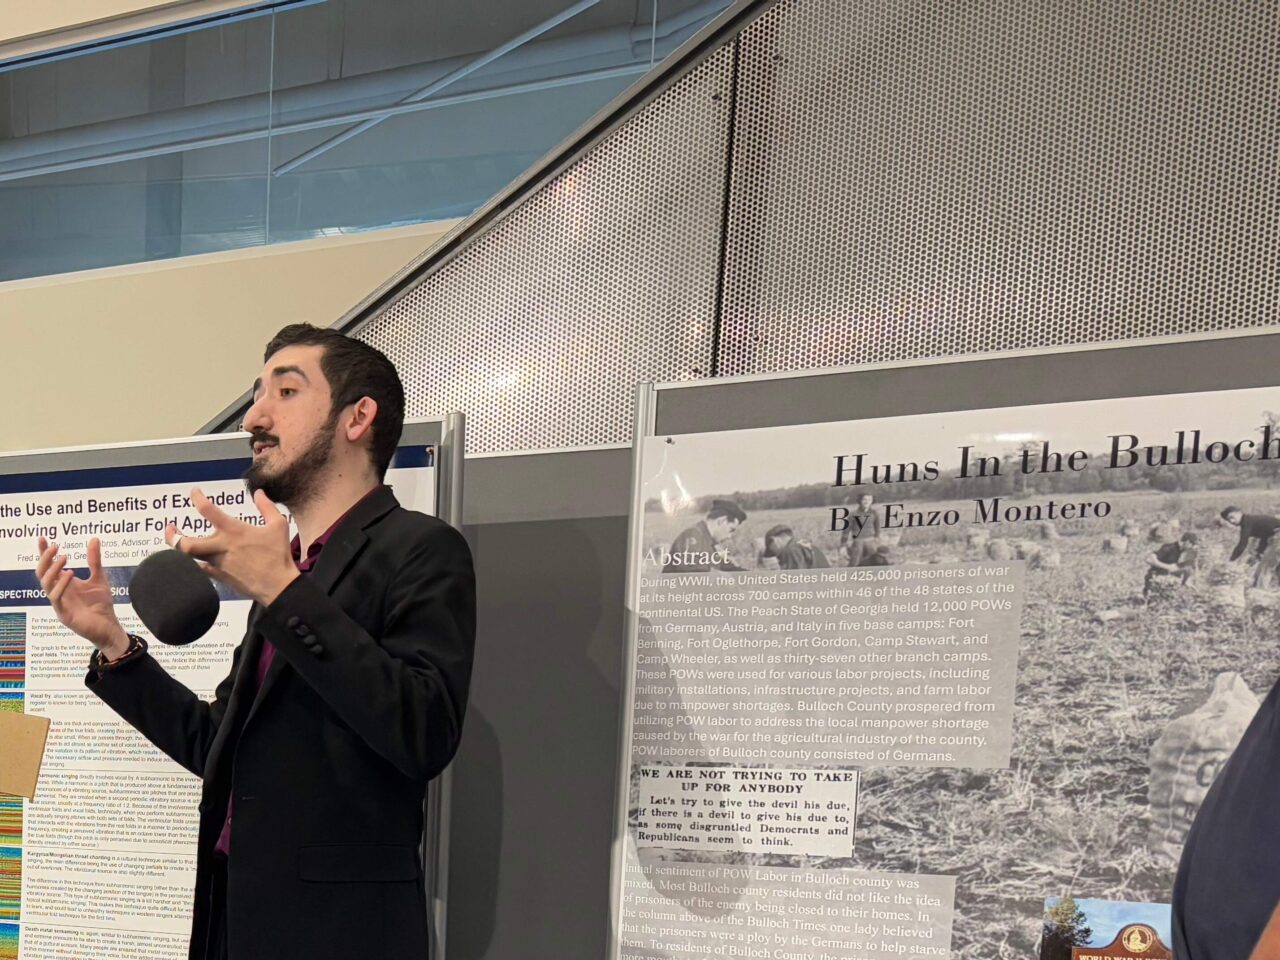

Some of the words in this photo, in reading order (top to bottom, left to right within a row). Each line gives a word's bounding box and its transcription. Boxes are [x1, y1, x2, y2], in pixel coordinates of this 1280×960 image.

[831, 453, 940, 488] Huns
[954, 445, 1002, 479] In
[1018, 441, 1089, 475] the
[1105, 425, 1280, 469] Bulloch
[0, 504, 21, 518] the
[26, 502, 53, 516] Use
[57, 501, 84, 515] and
[89, 496, 150, 513] Benefits
[152, 494, 168, 510] of
[172, 490, 245, 508] Exnded
[828, 506, 870, 538] By
[881, 503, 961, 529] Enzo
[972, 498, 1113, 525] Montero
[62, 519, 139, 537] Ventricular
[62, 541, 84, 549] Jason
[17, 554, 34, 562] Fred
[104, 551, 132, 559] School
[133, 550, 140, 558] of
[642, 547, 731, 567] Abstract
[639, 575, 677, 590] During
[678, 573, 712, 589] WWII,
[716, 573, 735, 585] the
[737, 571, 777, 584] United
[779, 570, 817, 583] States
[820, 569, 847, 581] held
[850, 567, 901, 584] 425,000
[904, 565, 964, 582] prisoners
[968, 565, 981, 577] of
[984, 567, 1009, 576] war
[637, 605, 700, 617] continental
[704, 604, 723, 616] US.
[728, 604, 748, 615] The
[751, 603, 787, 615] Peach
[790, 602, 821, 614] State
[825, 602, 837, 613] of
[840, 601, 888, 616] Georgia
[891, 600, 919, 612] held
[923, 599, 967, 615] 12,000
[970, 598, 1011, 610] POWs
[636, 637, 683, 652] Benning,
[687, 636, 709, 648] Fort
[712, 635, 780, 651] Oglethorpe,
[784, 635, 808, 647] Fort
[811, 634, 860, 650] Gordon,
[865, 634, 902, 649] Camp
[905, 633, 959, 648] Stewart,
[963, 632, 987, 644] and
[641, 770, 659, 779] WE
[667, 770, 692, 779] ARE
[699, 770, 725, 780] NOT
[732, 771, 781, 781] TRYING
[789, 771, 806, 781] TO
[814, 772, 852, 782] TAKE
[682, 783, 698, 792] UP
[705, 783, 730, 793] FOR
[739, 783, 802, 794] ANYBODY
[650, 796, 675, 805] Let's
[681, 797, 697, 808] try
[703, 797, 713, 806] to
[719, 798, 742, 809] give
[748, 798, 765, 807] the
[771, 799, 797, 808] devil
[804, 800, 820, 809] his
[826, 800, 849, 812] due,
[651, 808, 677, 817] there
[683, 809, 691, 817] is
[708, 809, 734, 819] devil
[740, 810, 750, 819] to
[757, 811, 780, 822] give
[786, 812, 801, 821] his
[807, 812, 827, 822] due
[834, 813, 848, 824] to,
[689, 821, 750, 834] disgruntled
[760, 824, 819, 834] Democrats
[828, 826, 848, 835] and
[638, 832, 699, 845] Republicans
[707, 836, 733, 844] seem
[742, 835, 752, 844] to
[761, 836, 792, 846] think.
[660, 880, 685, 891] Most
[689, 881, 729, 894] Bulloch
[732, 884, 769, 899] county
[772, 886, 821, 899] residents
[824, 889, 843, 900] did
[846, 890, 864, 901] not
[869, 891, 890, 903] like
[894, 893, 912, 904] the
[916, 894, 940, 905] idea
